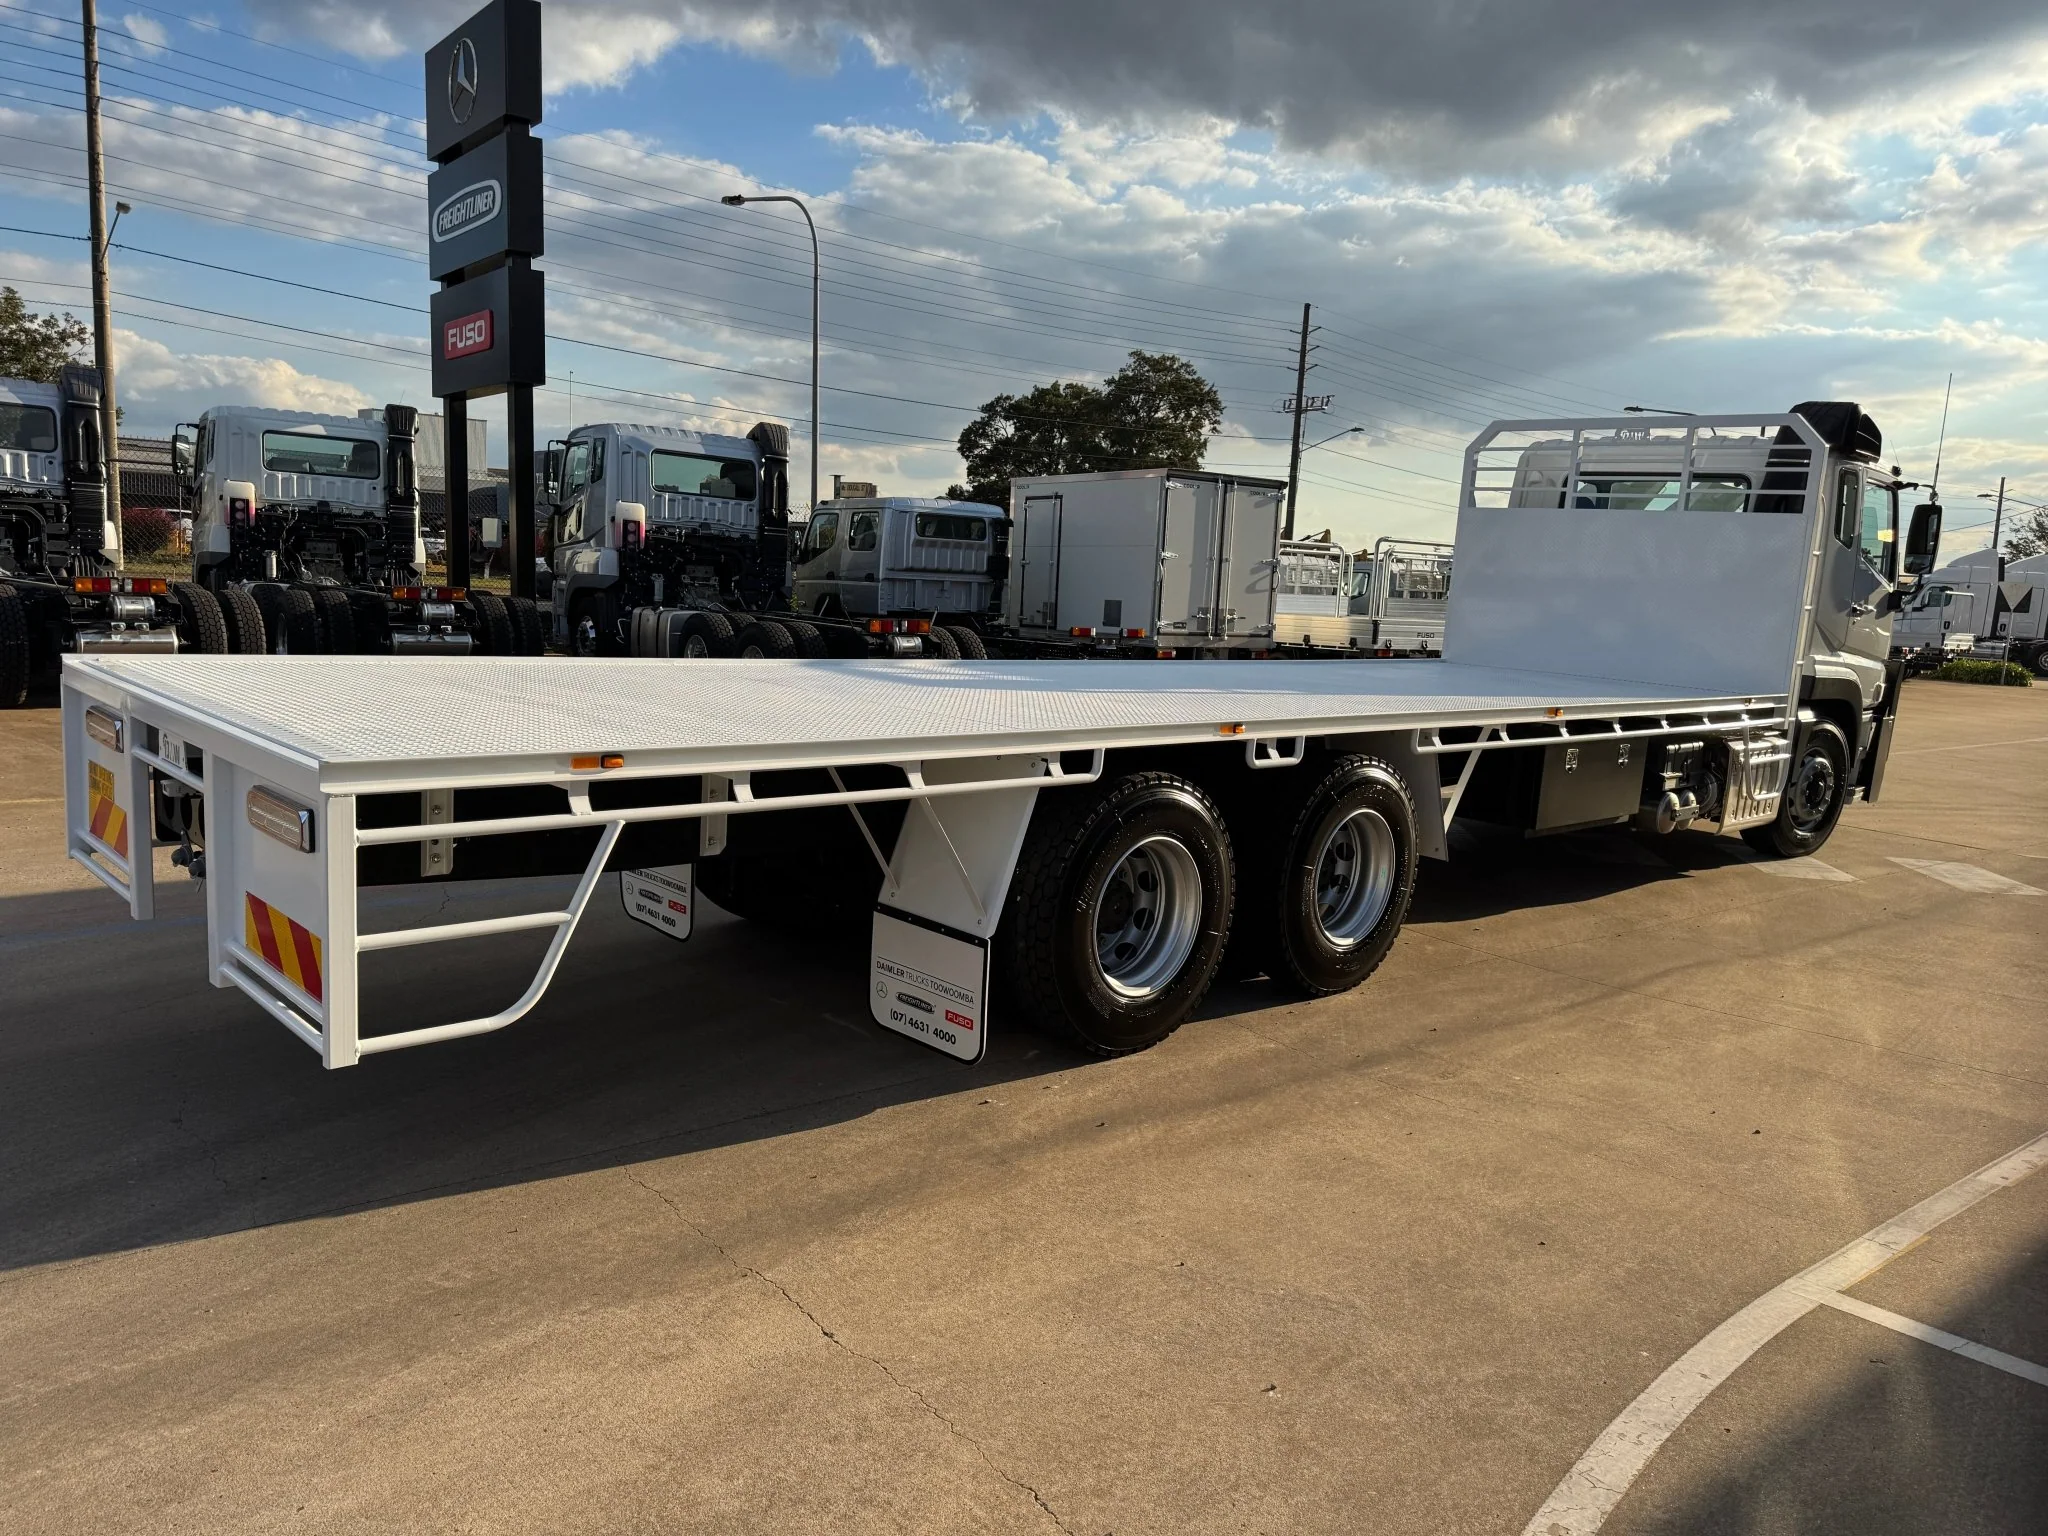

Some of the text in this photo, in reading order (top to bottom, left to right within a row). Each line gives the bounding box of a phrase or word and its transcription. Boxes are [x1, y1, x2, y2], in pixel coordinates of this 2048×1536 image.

[438, 191, 494, 232] FREIGHTLINER
[447, 318, 486, 351] FUSO
[635, 901, 676, 928] (07) 4631 4000
[876, 960, 975, 1005] DAIMLER TRUCKS TOOWOOMBA
[890, 1008, 957, 1045] (07) 4631 4000
[947, 1012, 972, 1028] FUSO
